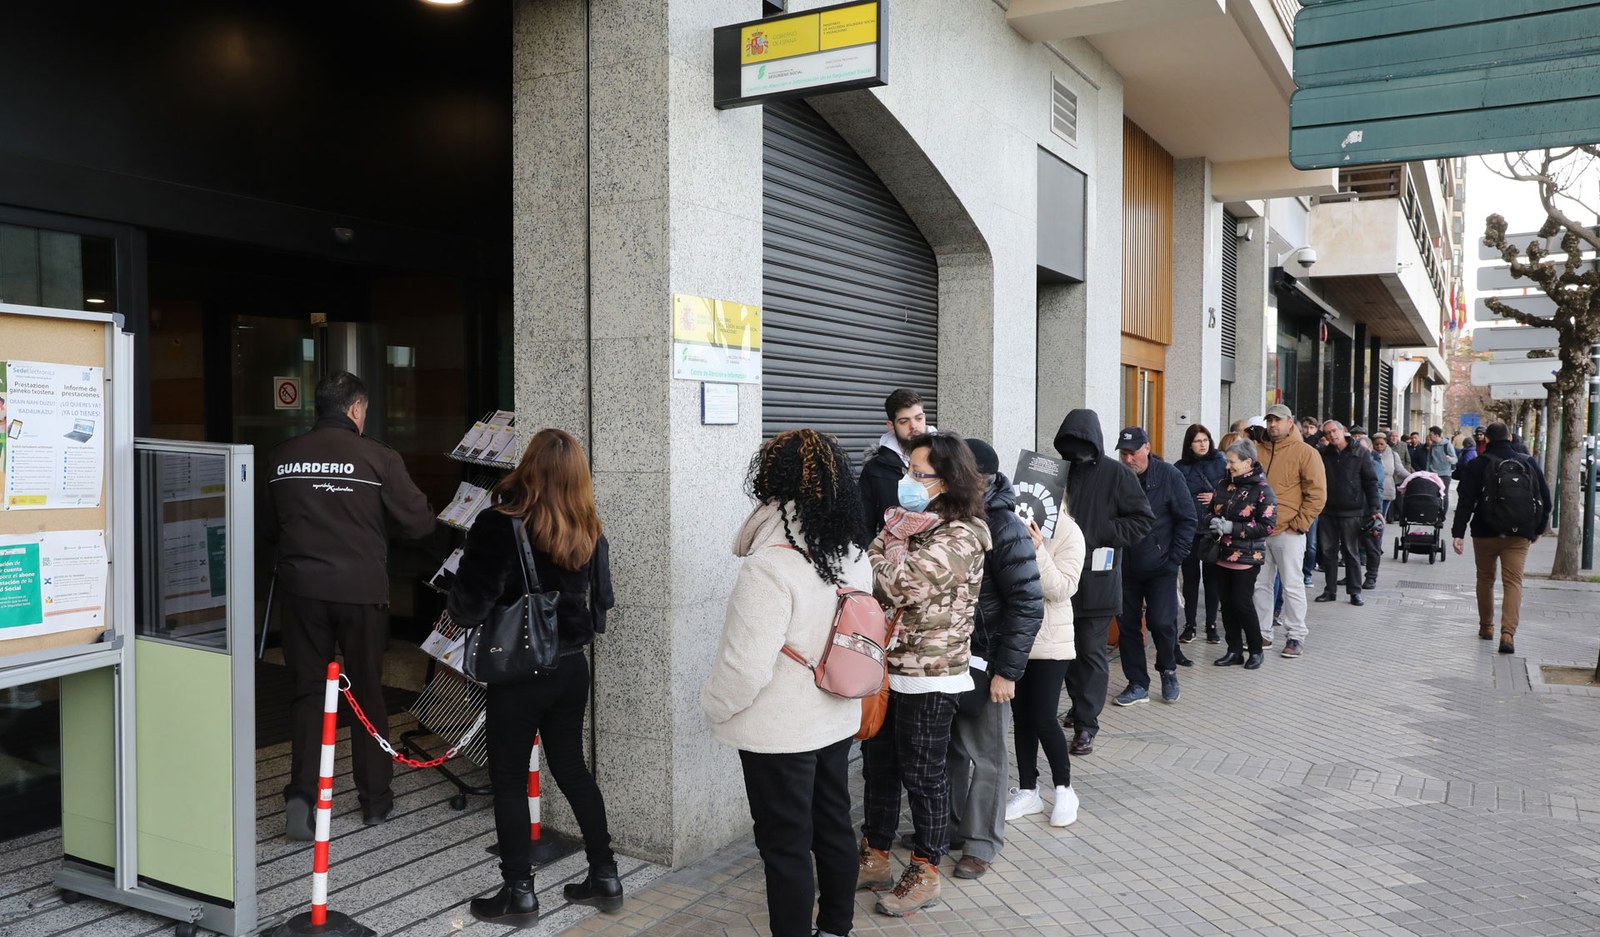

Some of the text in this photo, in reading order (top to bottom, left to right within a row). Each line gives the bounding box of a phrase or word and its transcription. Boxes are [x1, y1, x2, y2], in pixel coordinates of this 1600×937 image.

[14, 381, 50, 389] Prestazioen
[64, 384, 88, 392] Informe
[61, 391, 100, 399] prestaciones
[277, 462, 355, 475] GUARDERIO
